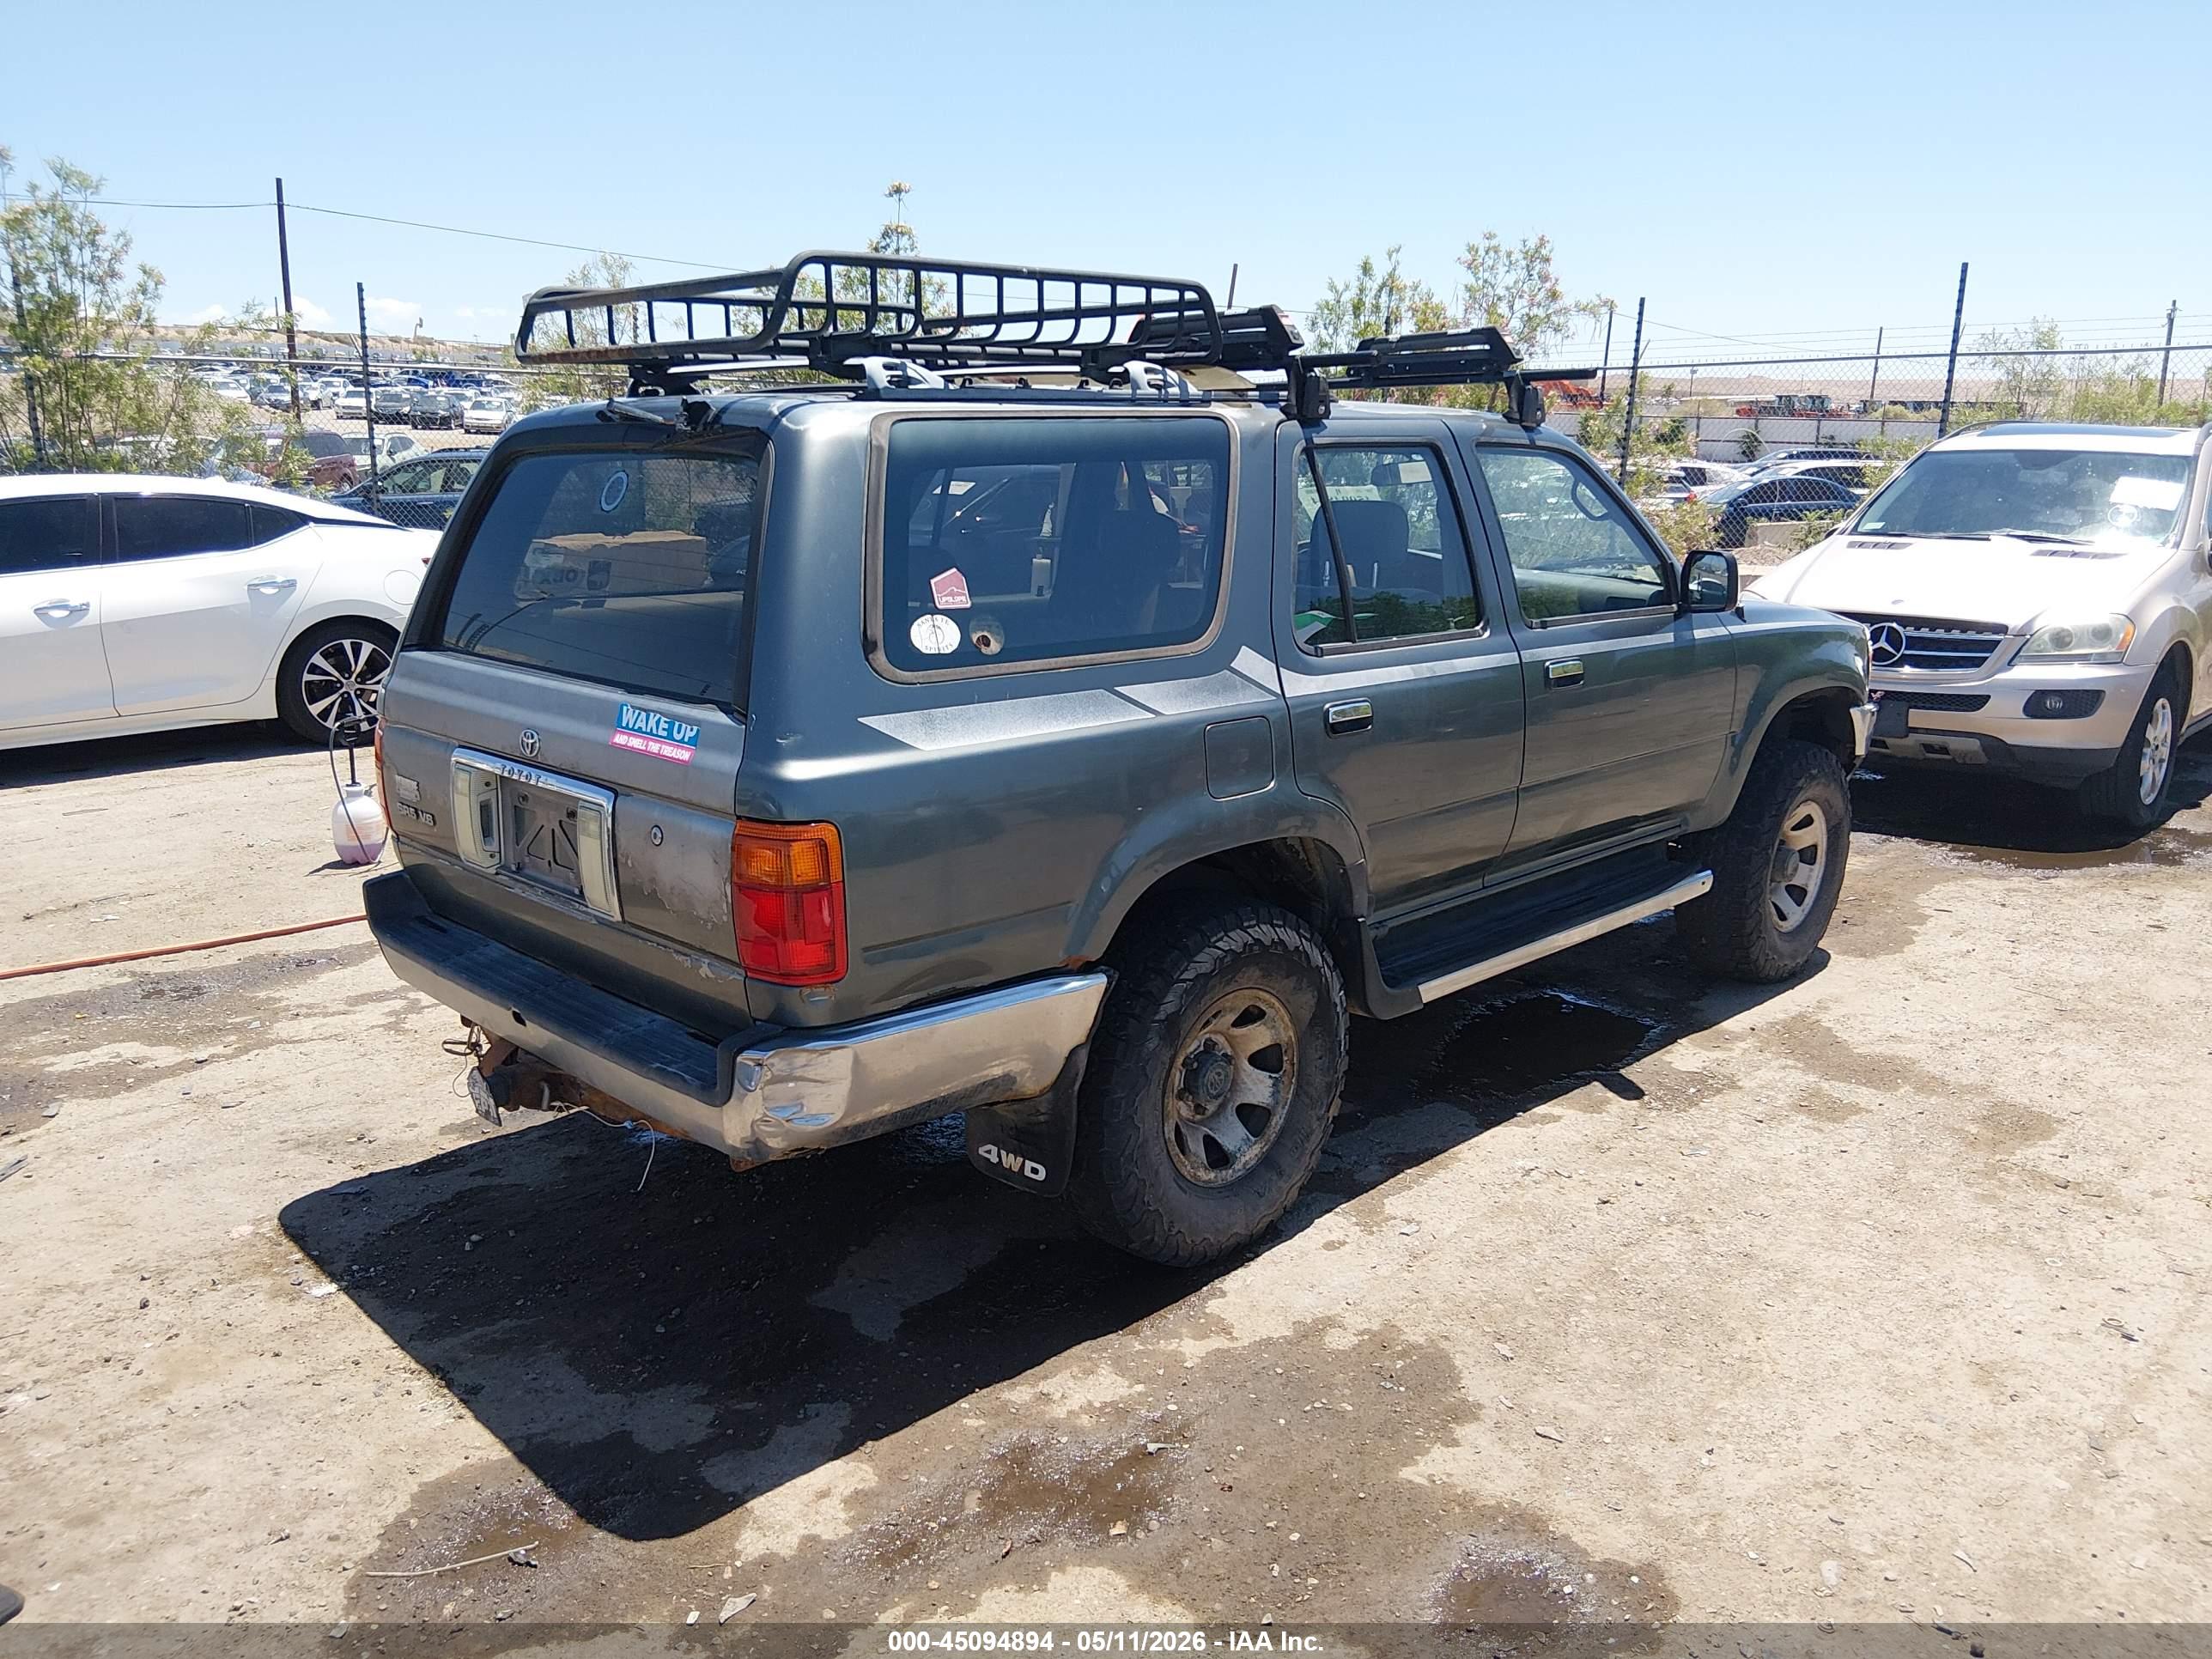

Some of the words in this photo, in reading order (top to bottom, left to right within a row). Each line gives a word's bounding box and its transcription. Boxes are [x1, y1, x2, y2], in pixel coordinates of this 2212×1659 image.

[622, 705, 670, 737] WAKE
[672, 720, 698, 743] UP
[613, 734, 628, 745] AND
[628, 737, 647, 750] SMELL
[647, 741, 660, 753] THE
[660, 744, 691, 761] TREASON
[978, 1143, 1047, 1182] 4WD
